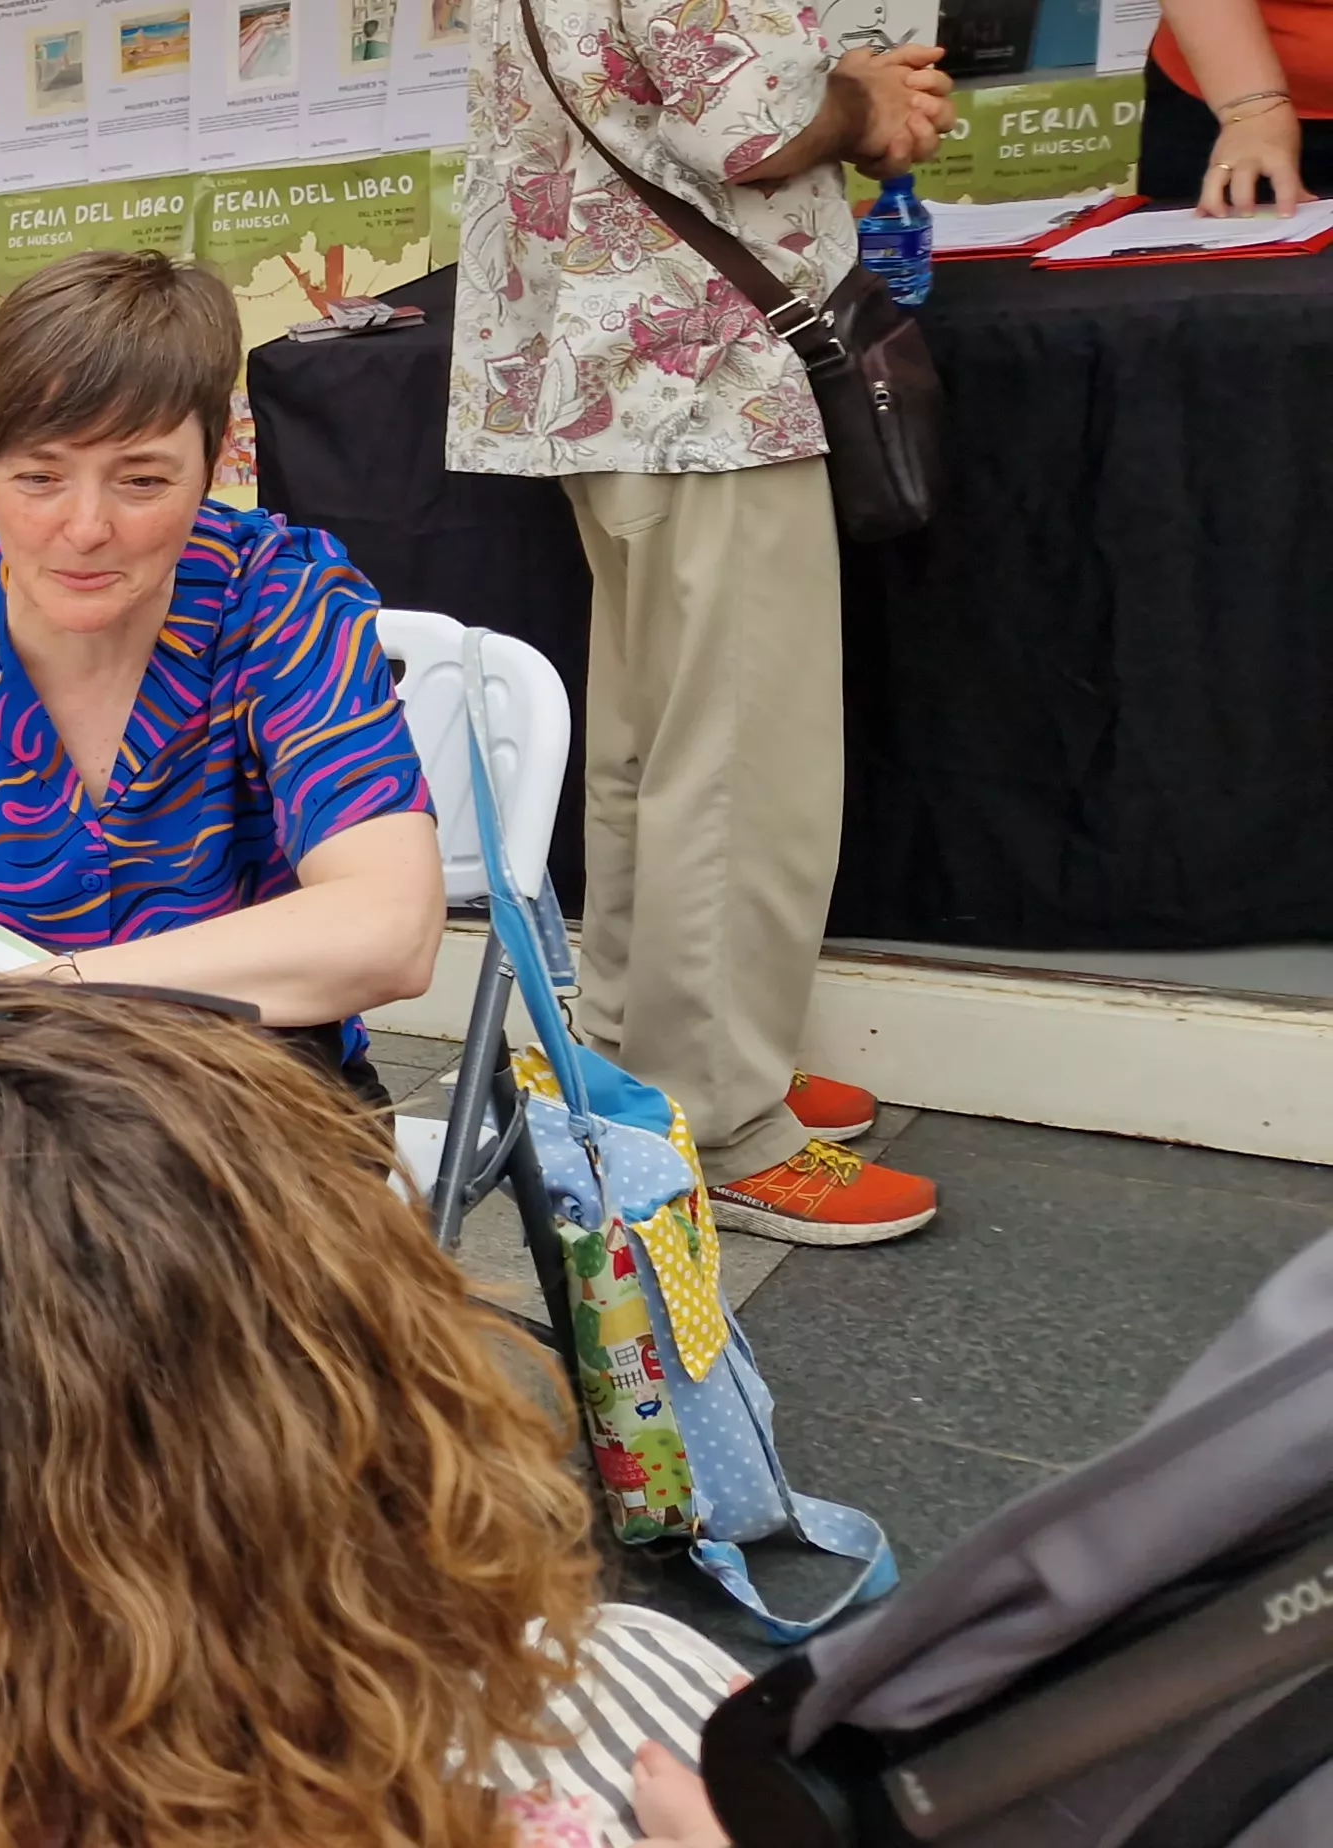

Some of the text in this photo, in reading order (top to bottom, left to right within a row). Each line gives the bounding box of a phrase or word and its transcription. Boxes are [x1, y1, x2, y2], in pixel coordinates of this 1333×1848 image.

[1000, 103, 1099, 137] FERIA
[999, 135, 1111, 159] DE HUESCA
[214, 174, 414, 214] FERIA DEL LIBRO
[9, 195, 184, 231] FERIA DEL LIBRO
[213, 213, 290, 232] DE HUESCA
[7, 231, 73, 249] DE HUESCA
[712, 1185, 774, 1213] MERRELL
